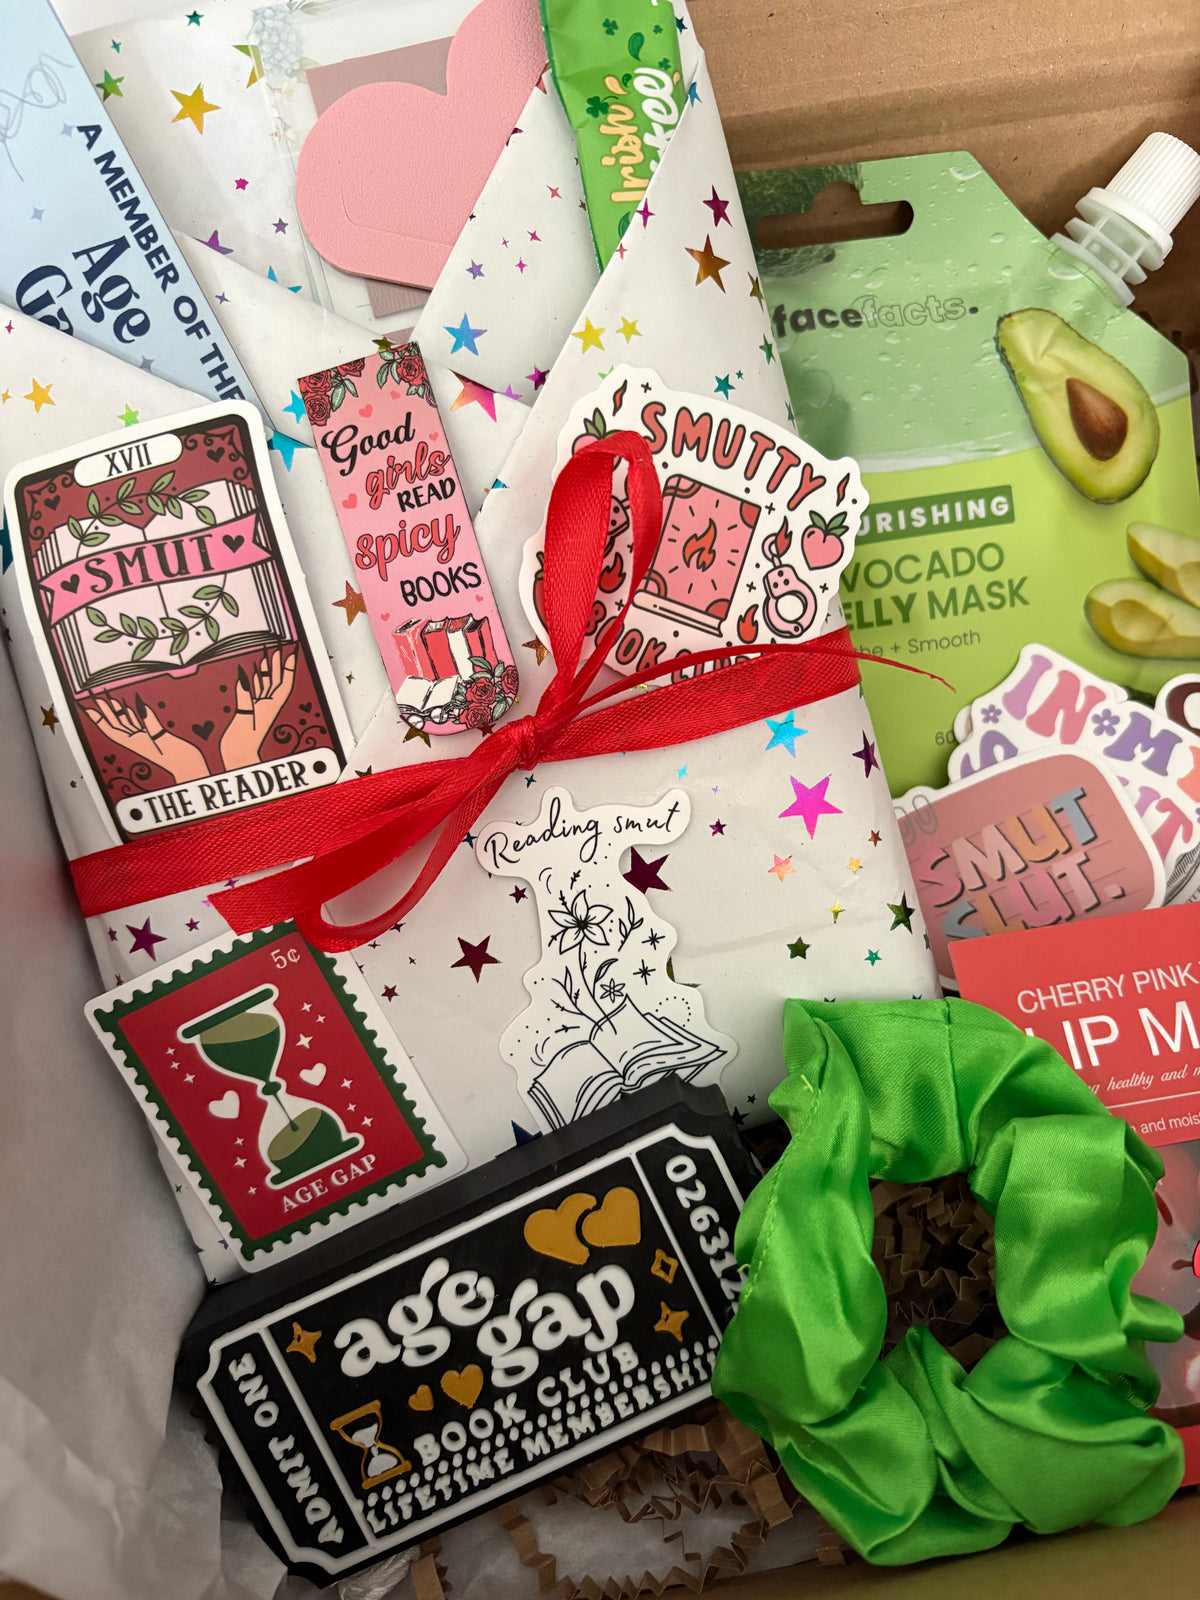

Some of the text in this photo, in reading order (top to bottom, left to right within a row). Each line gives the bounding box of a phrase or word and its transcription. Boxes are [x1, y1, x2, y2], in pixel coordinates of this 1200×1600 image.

[599, 104, 650, 202] Irish
[76, 124, 103, 151] A
[94, 150, 180, 293] MEMBER
[173, 295, 211, 340] OF
[72, 235, 151, 344] Age
[106, 443, 153, 477] XVII
[321, 412, 416, 477] Good
[365, 440, 451, 510] girls
[640, 401, 827, 511] SMUTTY
[397, 476, 457, 512] READ
[85, 533, 215, 594] SMUT
[355, 514, 461, 582] spicy
[840, 541, 1006, 593] VOCADO
[400, 562, 482, 607] BOOKS
[844, 575, 1030, 631] ELLY MASK
[908, 630, 981, 654] Smooth
[1002, 654, 1107, 745] IN
[144, 760, 310, 824] THE READER
[484, 796, 681, 868] Reading smut
[912, 786, 1098, 908] SMUT
[270, 948, 301, 970] 5¢
[1017, 962, 1194, 1014] CHERRY PINK
[1024, 1014, 1120, 1070] IP
[1106, 1071, 1154, 1091] healthy
[1160, 1064, 1189, 1081] and
[1140, 1117, 1167, 1134] and
[1168, 1112, 1200, 1129] mois
[282, 1153, 378, 1213] AGE GAP
[334, 1257, 496, 1378] age
[476, 1264, 635, 1389] gap
[413, 1341, 641, 1466] BOOK CLUB
[227, 1352, 345, 1545] ADMIT ONE
[365, 1453, 517, 1534] LIFETIME
